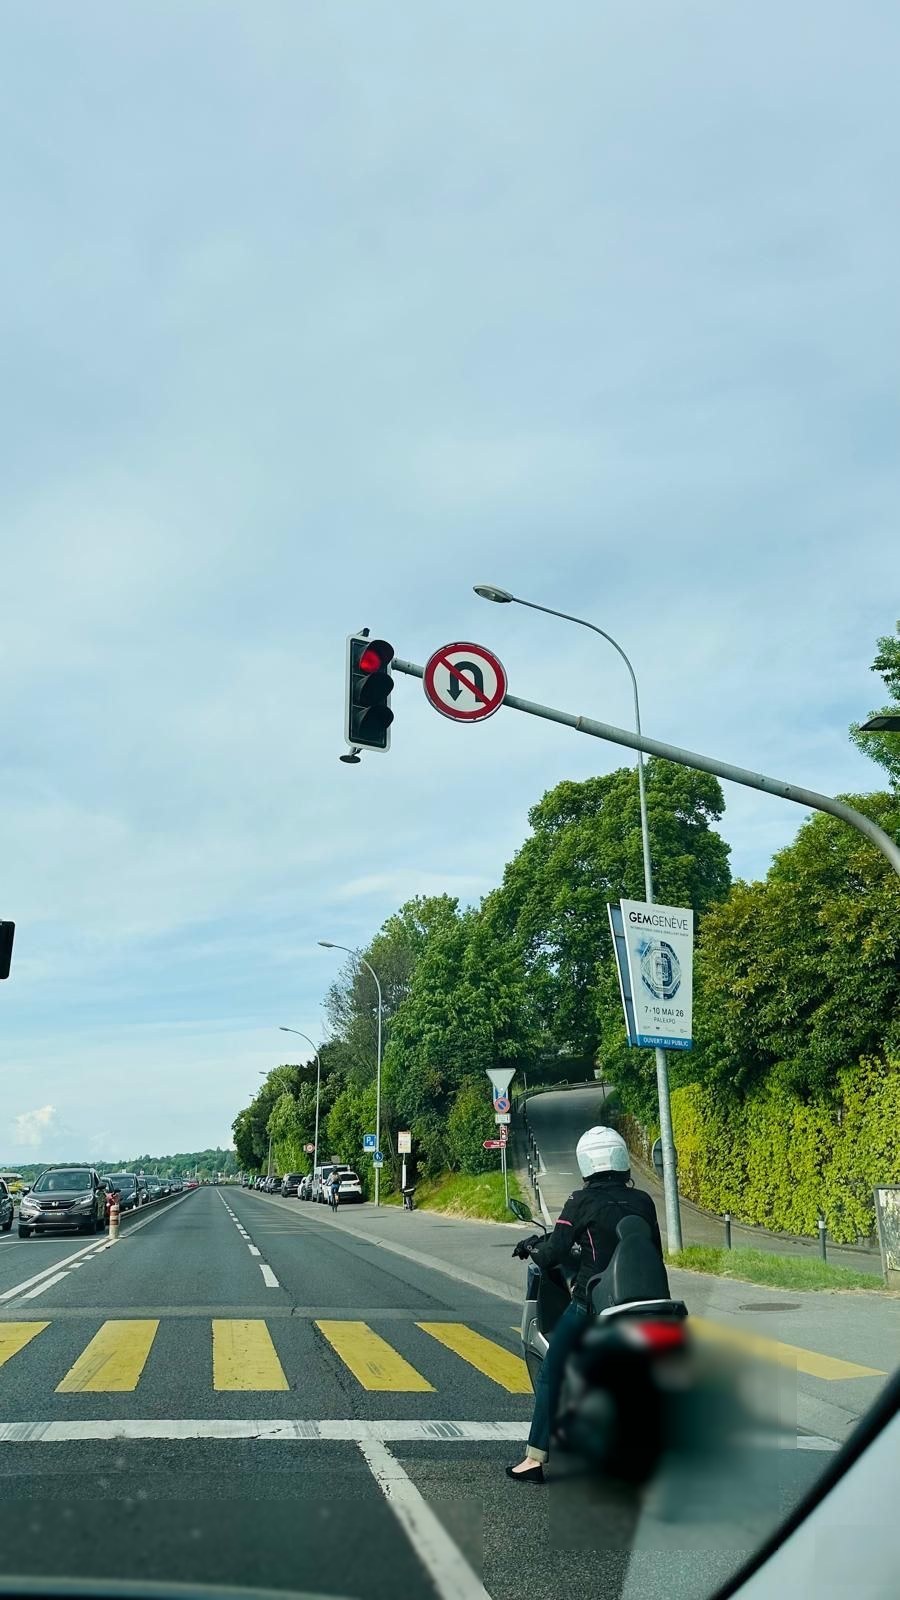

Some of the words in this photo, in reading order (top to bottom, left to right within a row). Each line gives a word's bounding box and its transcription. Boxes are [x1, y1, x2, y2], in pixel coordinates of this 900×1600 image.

[629, 912, 688, 930] GEMGENÈVE
[662, 1008, 674, 1016] MAI
[675, 1009, 684, 1017] 26
[671, 1039, 689, 1047] PUBLIC
[366, 1136, 371, 1144] P
